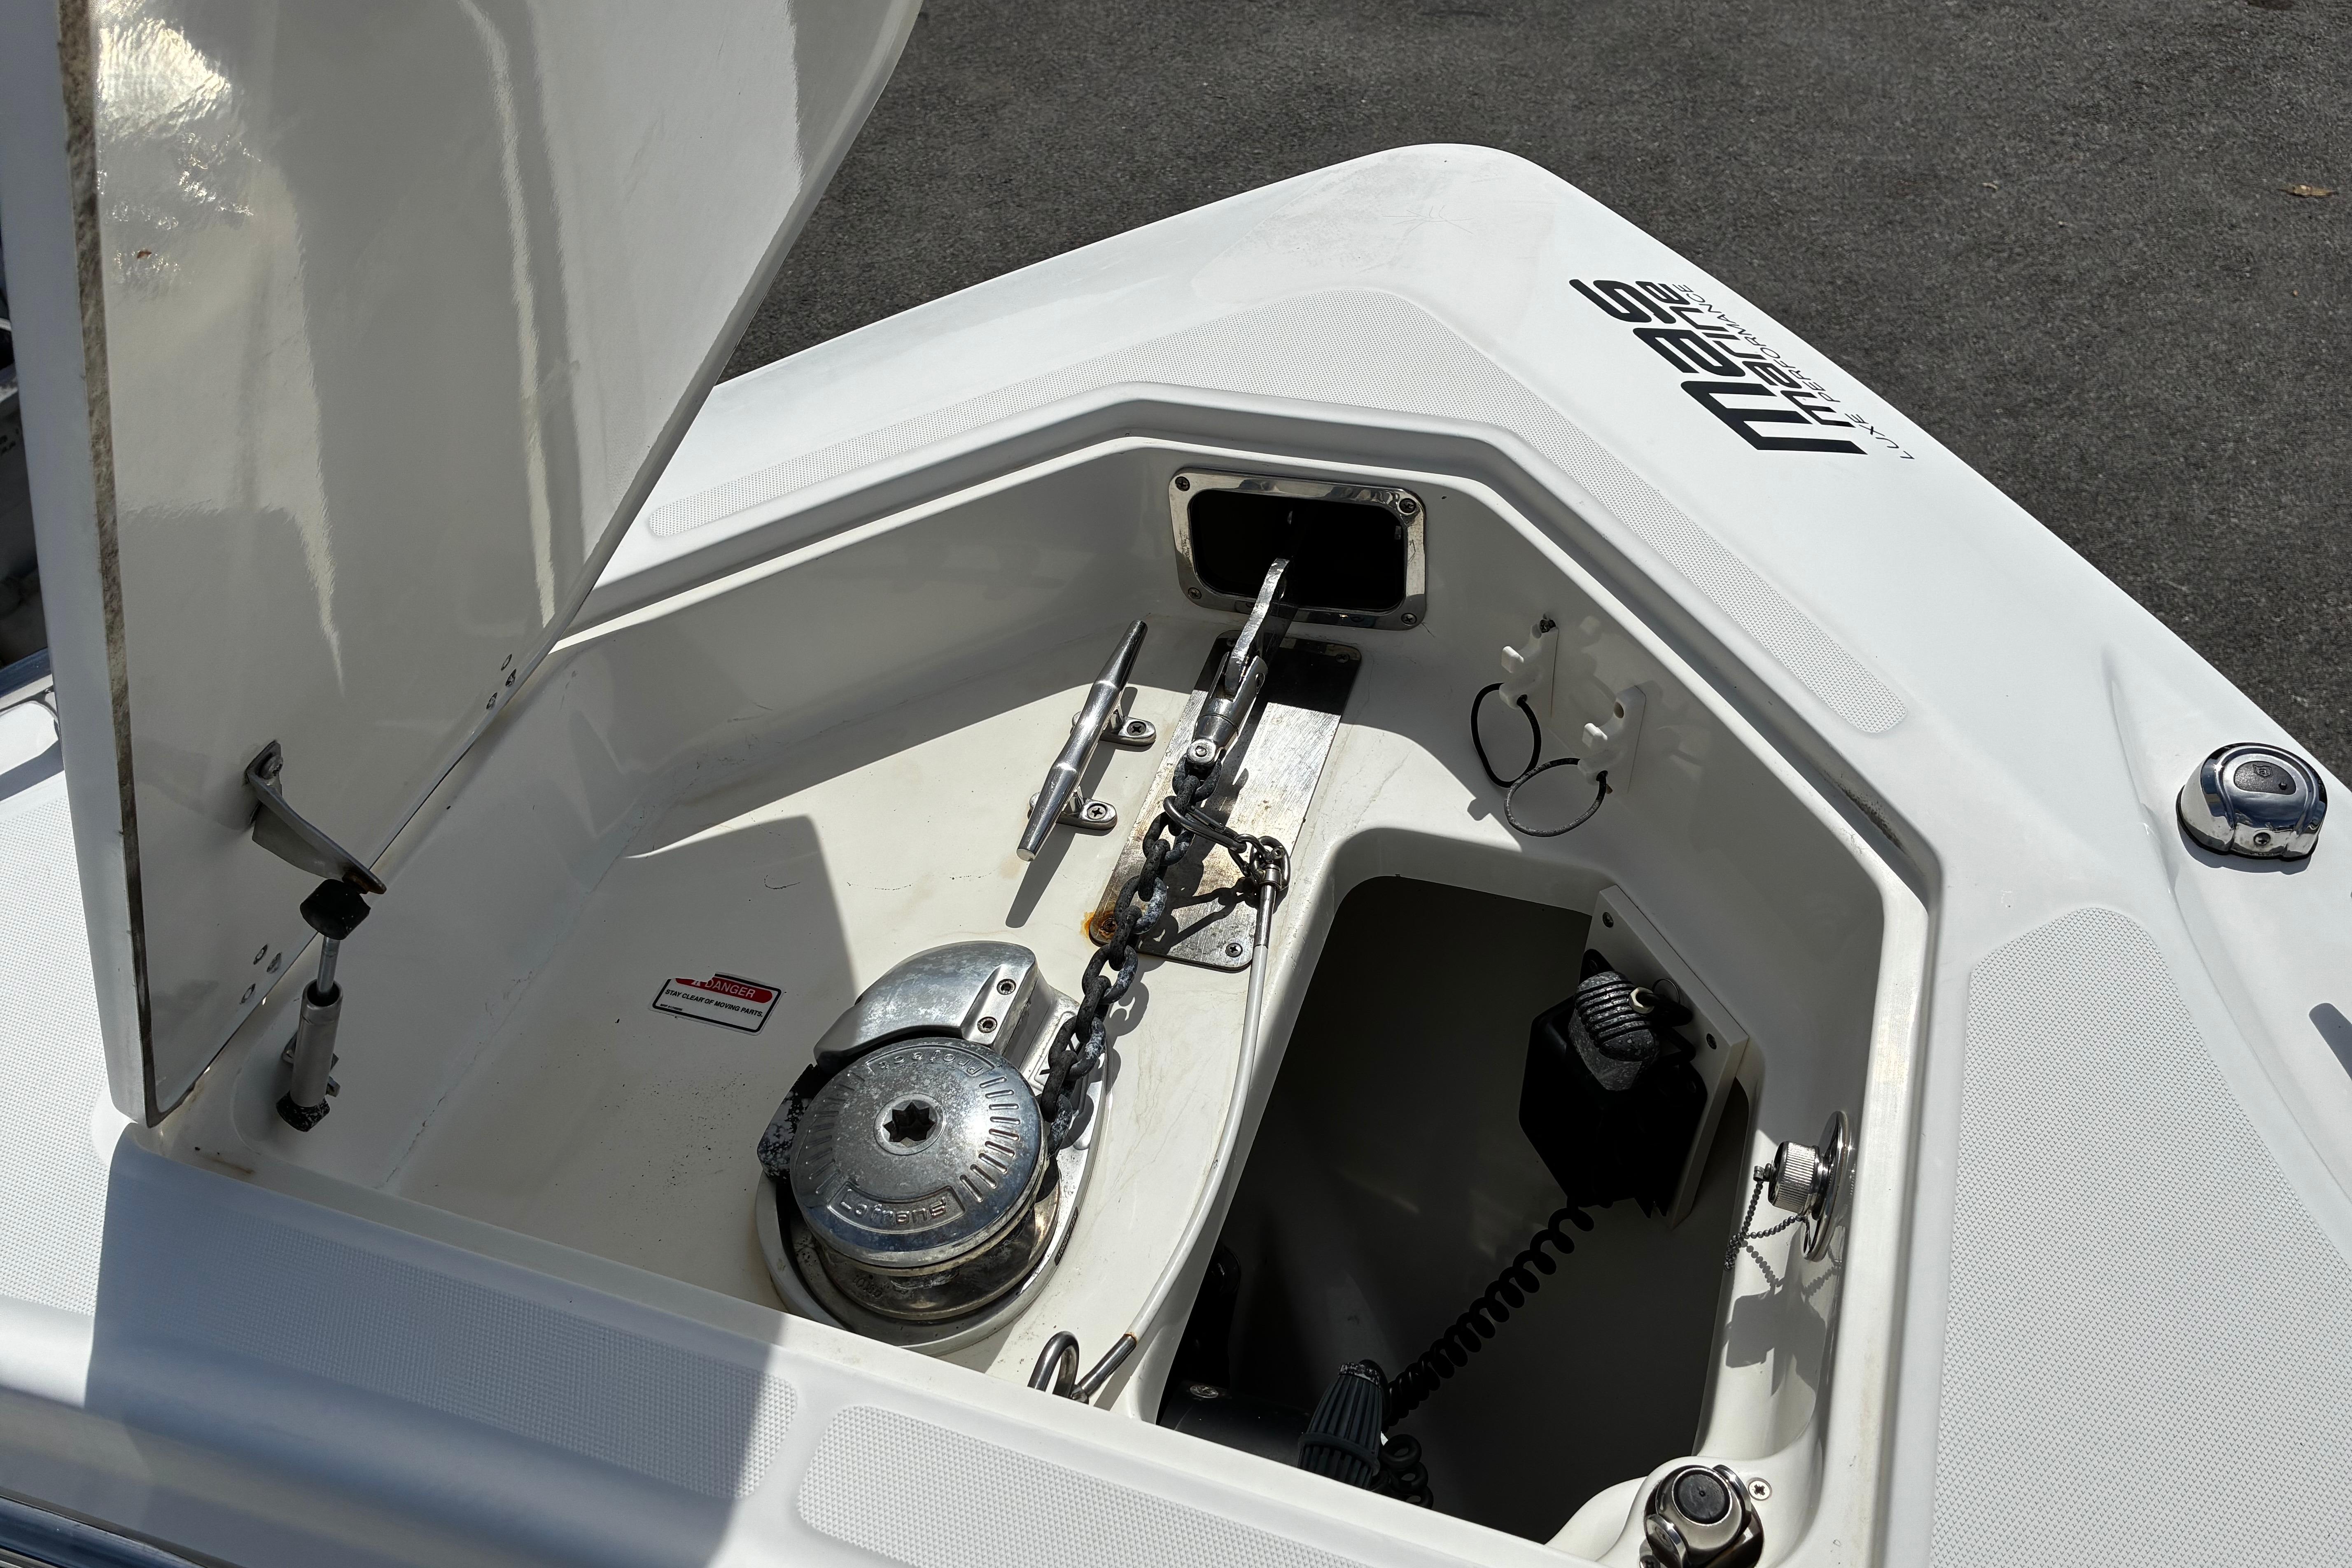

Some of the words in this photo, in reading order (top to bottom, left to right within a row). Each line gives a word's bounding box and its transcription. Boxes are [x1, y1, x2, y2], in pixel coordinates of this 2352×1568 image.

[1672, 284, 1841, 403] PERFORMANCE
[1844, 413, 1915, 460] LUXE
[681, 993, 705, 1003] CLEAR
[714, 1001, 740, 1011] MOVING
[740, 1007, 763, 1017] PARTS.
[705, 979, 756, 998] DANGER
